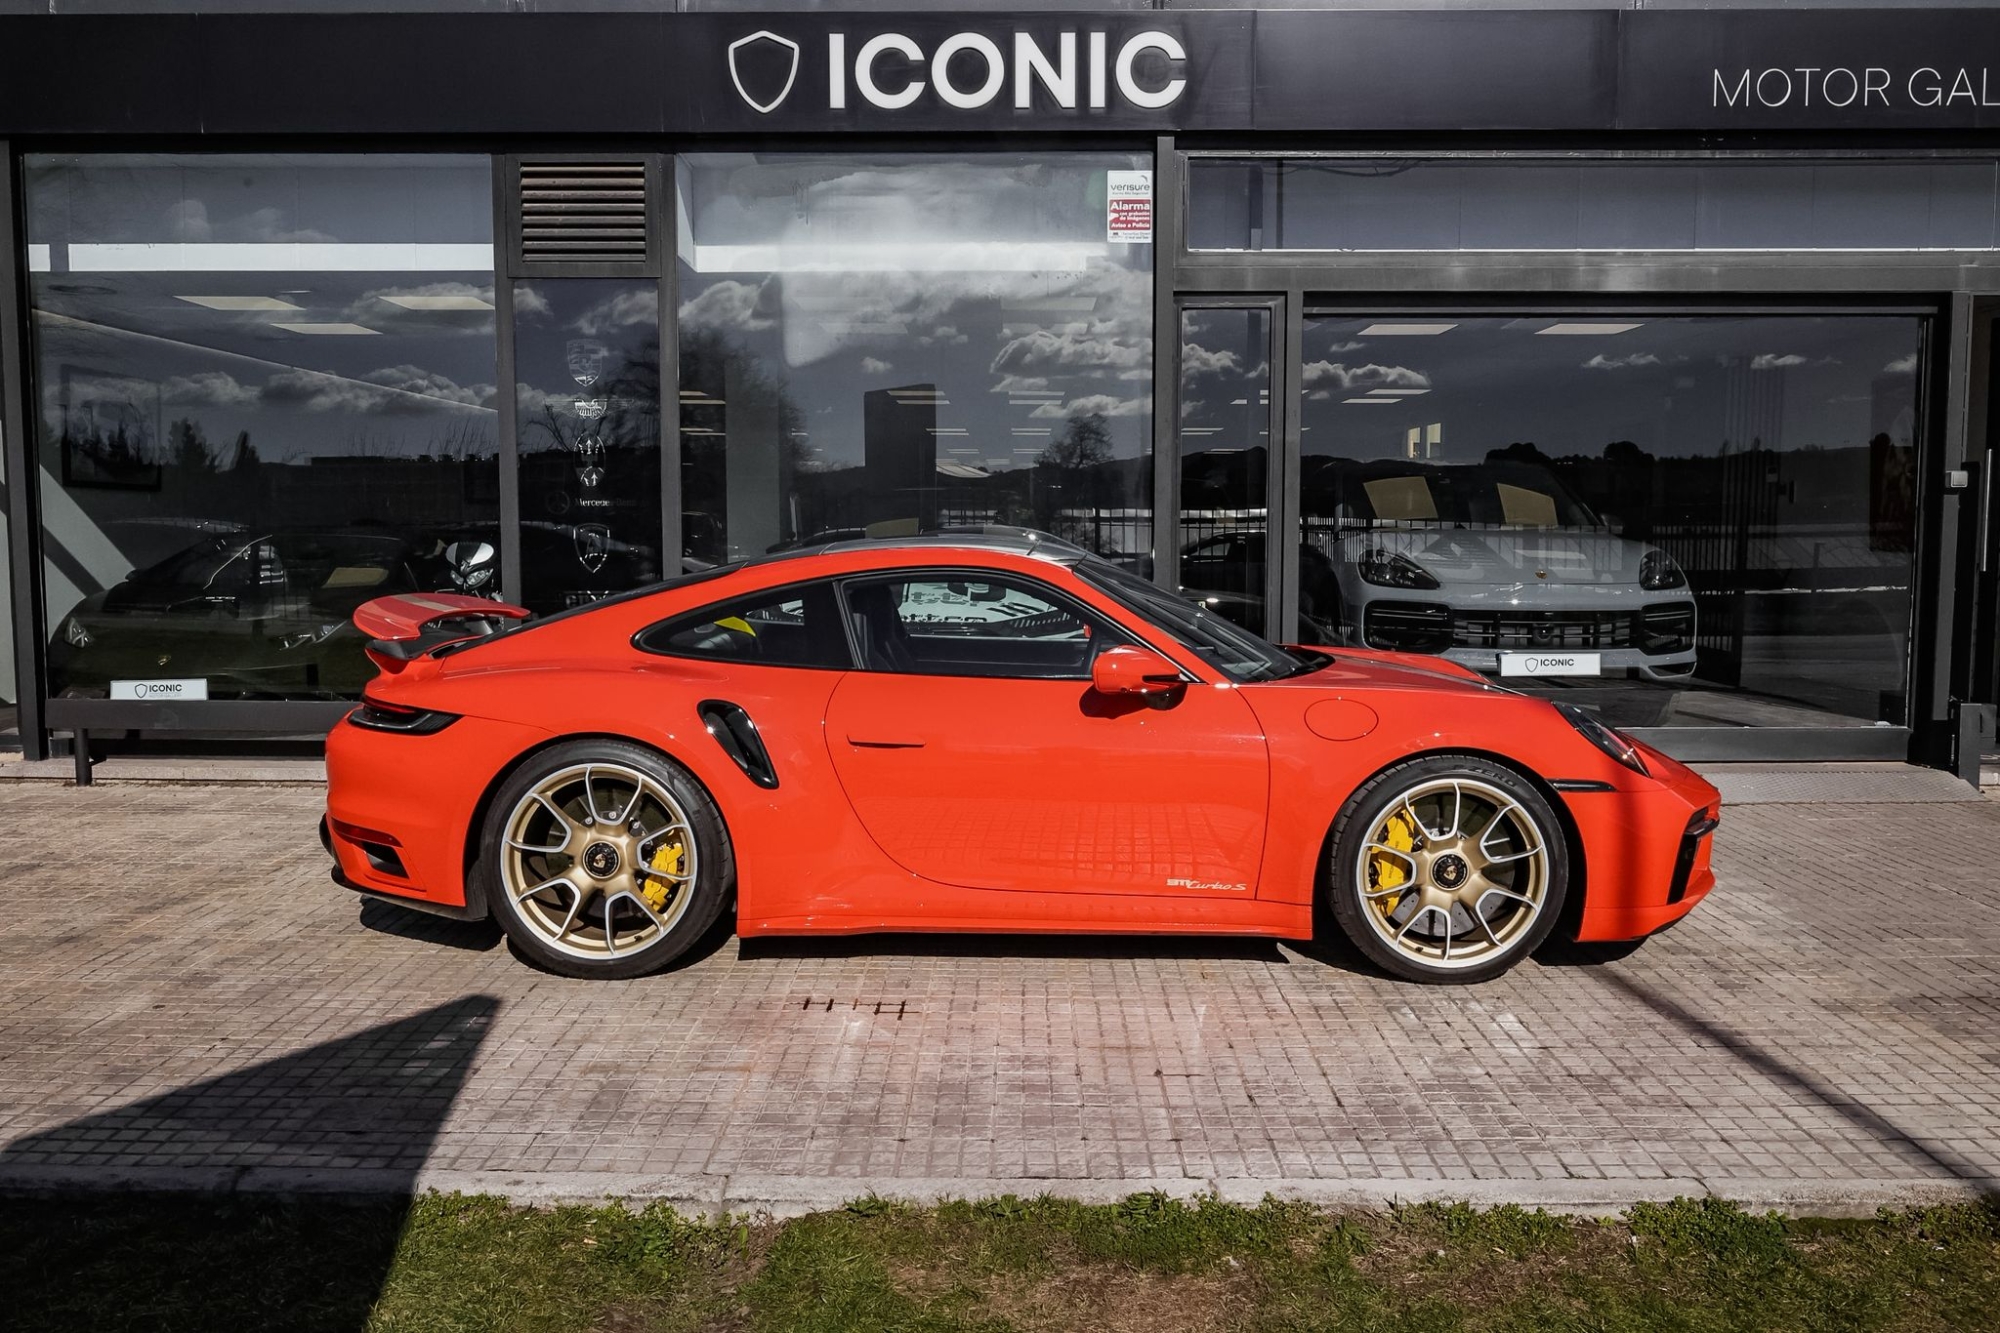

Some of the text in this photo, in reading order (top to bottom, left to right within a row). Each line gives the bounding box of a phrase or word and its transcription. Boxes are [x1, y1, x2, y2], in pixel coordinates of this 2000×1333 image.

[828, 30, 1187, 109] ICONIC
[1713, 67, 2000, 107] MOTOR GAL
[1110, 183, 1150, 191] verisure
[1110, 200, 1150, 211] Alarma
[1540, 658, 1574, 667] ICONIC
[149, 684, 182, 693] ICONIC
[1231, 883, 1247, 891] S
